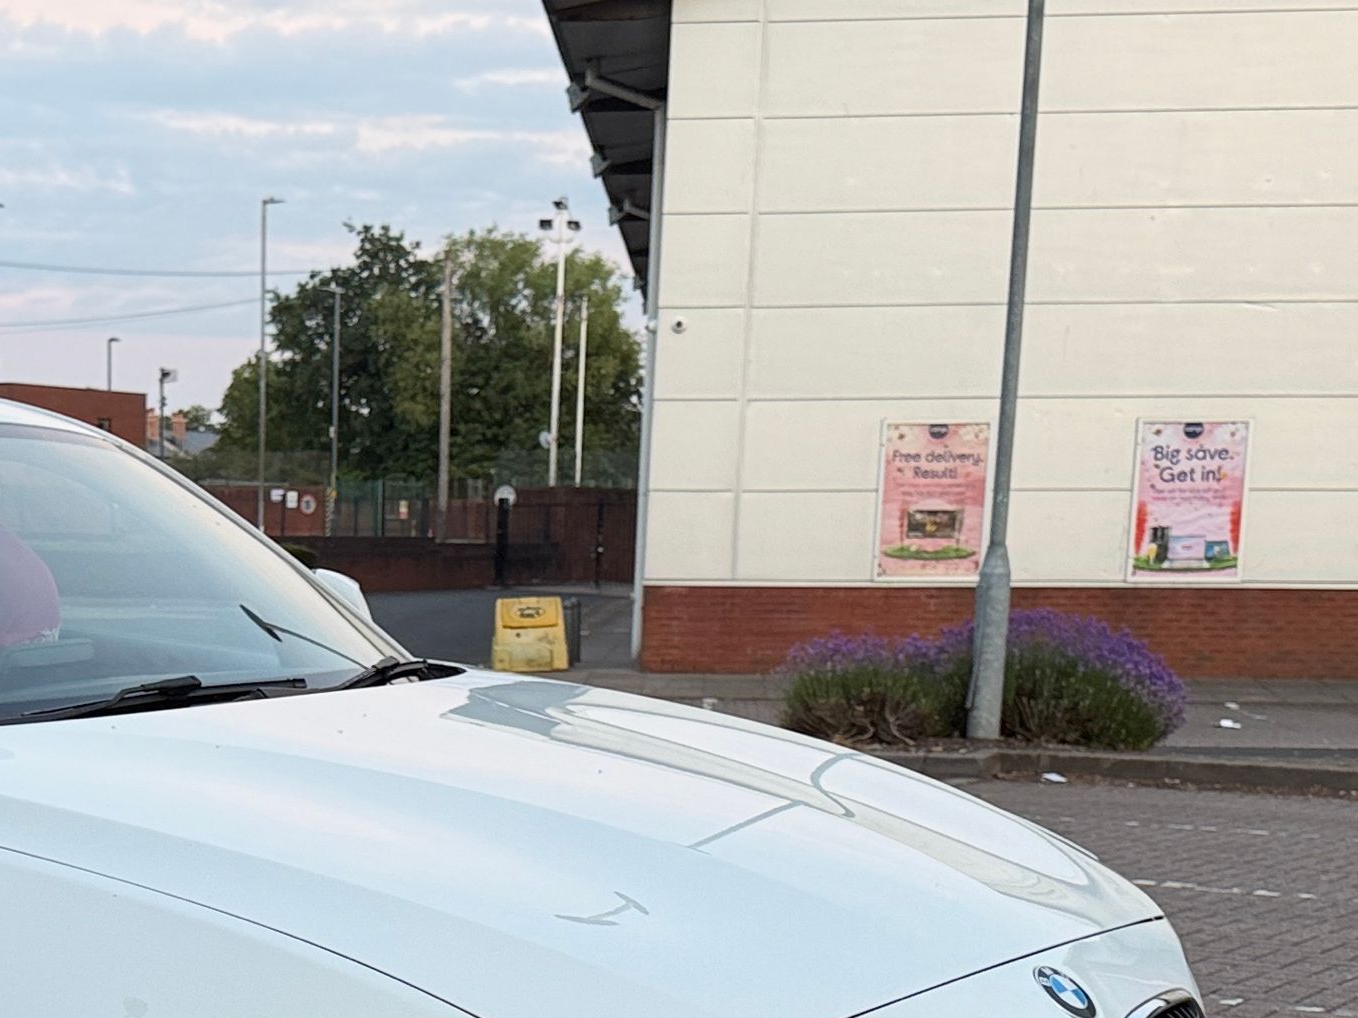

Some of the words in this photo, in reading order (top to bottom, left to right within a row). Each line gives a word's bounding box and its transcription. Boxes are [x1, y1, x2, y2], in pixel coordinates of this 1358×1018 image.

[892, 449, 921, 463] Free
[1152, 445, 1181, 465] Big
[1185, 447, 1234, 461] save.
[1159, 466, 1196, 483] Get
